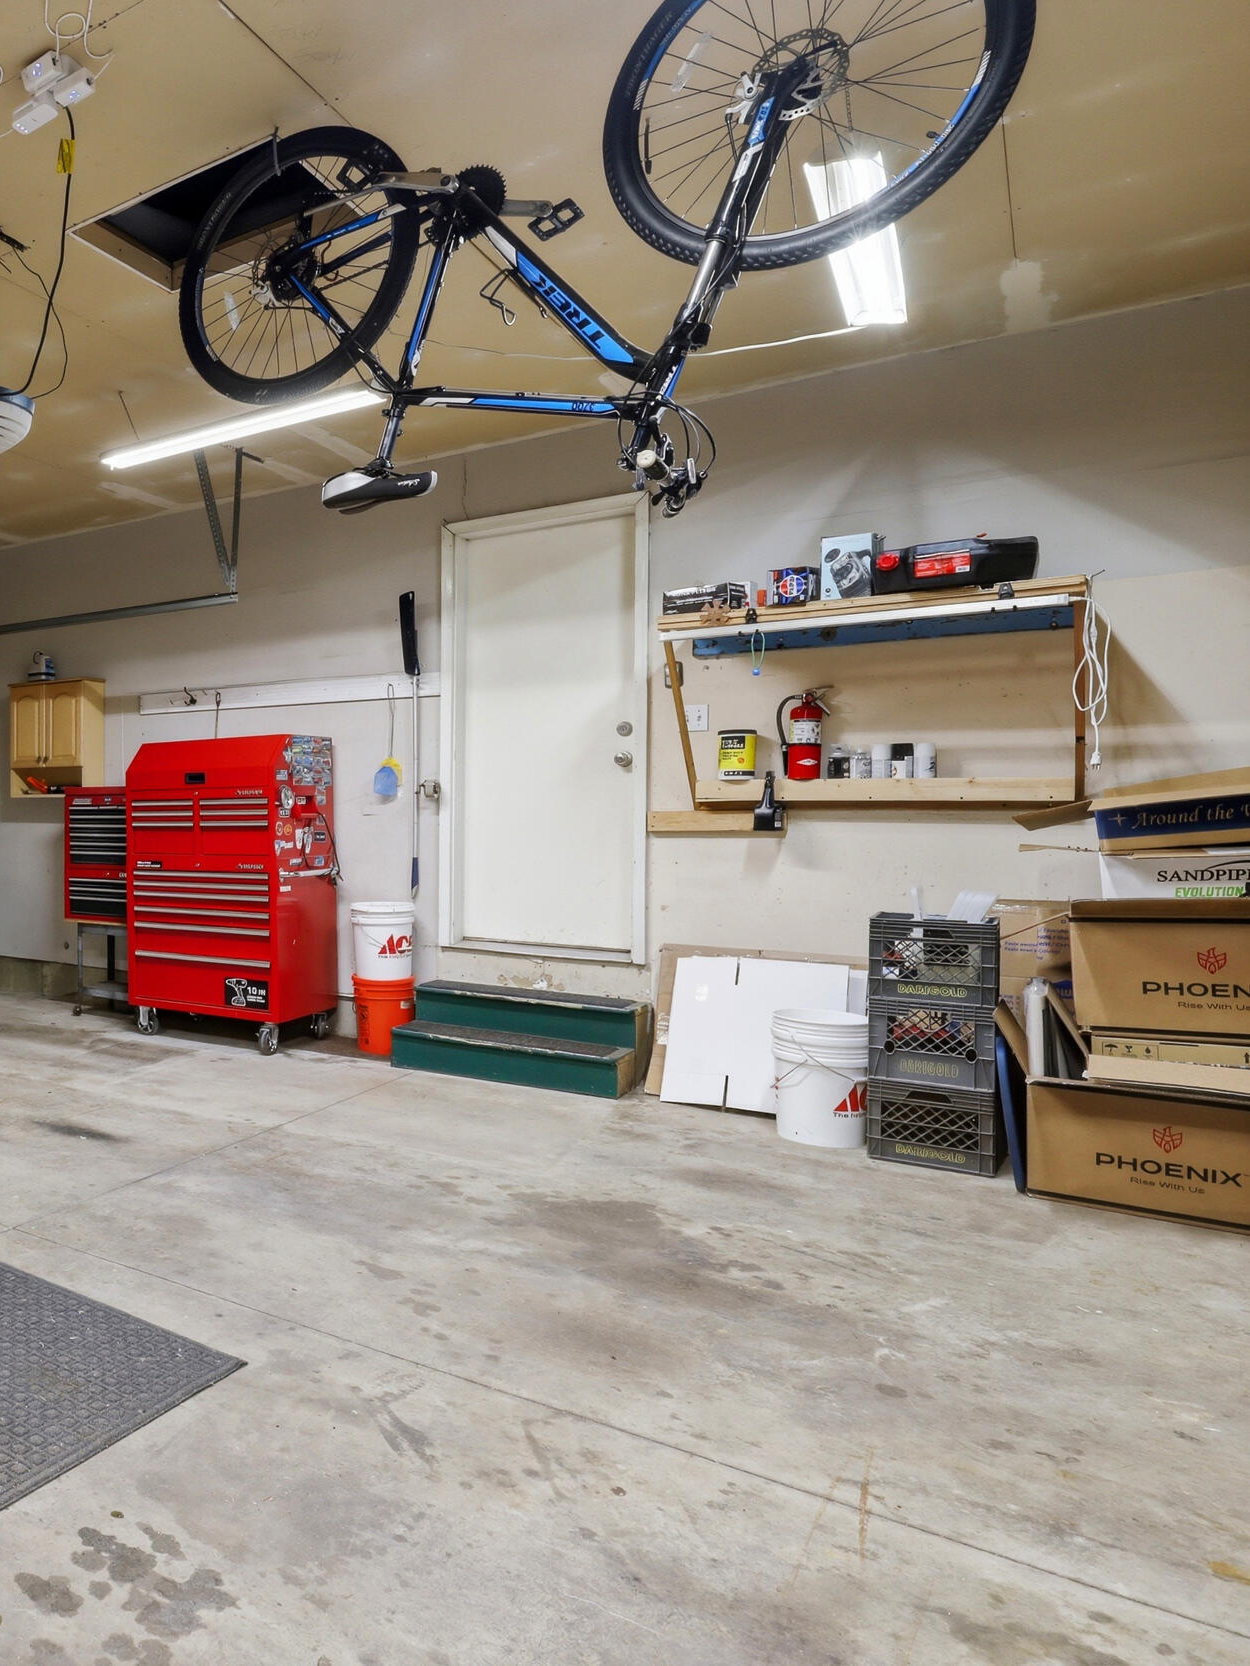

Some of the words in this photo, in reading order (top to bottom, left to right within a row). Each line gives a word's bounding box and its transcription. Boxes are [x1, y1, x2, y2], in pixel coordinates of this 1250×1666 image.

[532, 273, 605, 350] TREK
[1131, 804, 1203, 829] Around
[1206, 803, 1235, 820] the
[1157, 868, 1250, 882] SANDPIP
[1175, 886, 1244, 898] EVOLUTION
[246, 986, 258, 995] 10
[897, 983, 968, 998] DARIGOLD
[1177, 1001, 1204, 1009] Rise
[1206, 1002, 1232, 1011] With
[899, 1059, 959, 1079] DARIGOLD
[895, 1143, 966, 1164] DARIGOLD
[1095, 1152, 1243, 1188] PHOENIX
[1130, 1176, 1156, 1187] Rise
[1159, 1180, 1185, 1192] With
[1188, 1185, 1206, 1195] Us
